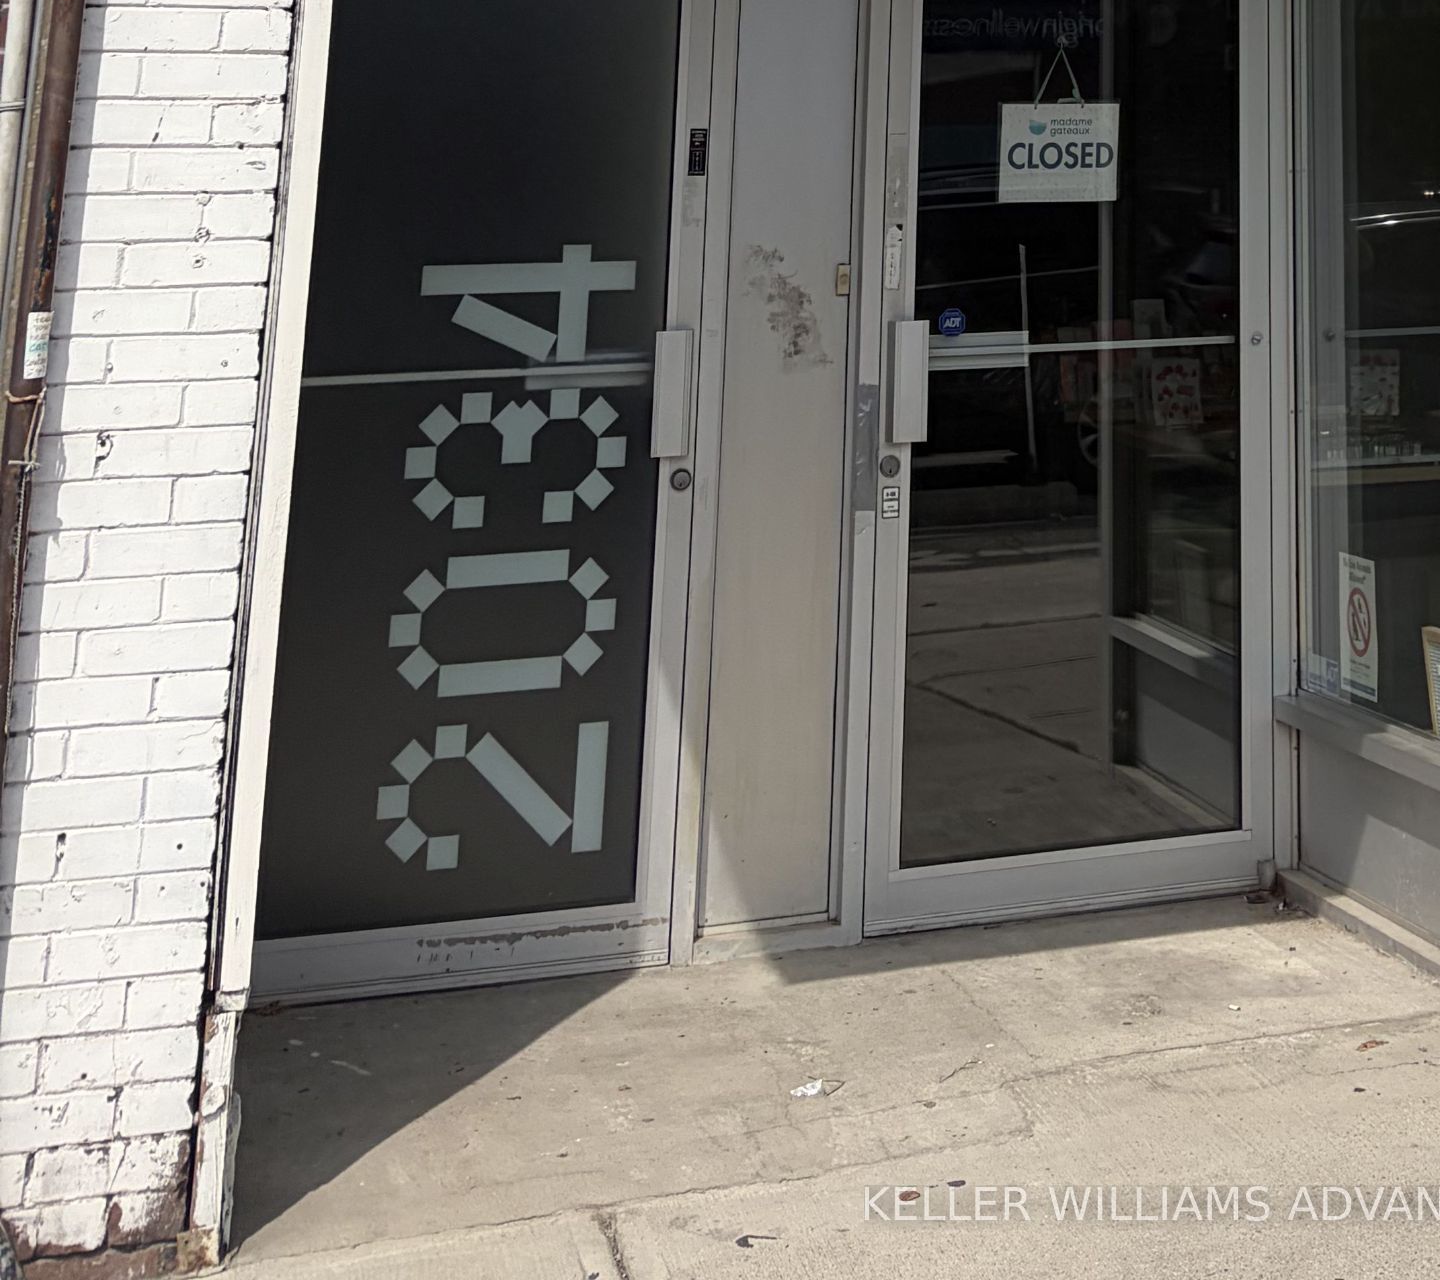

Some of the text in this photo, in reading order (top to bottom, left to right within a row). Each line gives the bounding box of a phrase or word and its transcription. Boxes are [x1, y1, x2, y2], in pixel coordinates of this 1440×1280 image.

[1050, 118, 1093, 127] madame
[1050, 127, 1090, 138] gateaux
[1007, 142, 1114, 170] CLOSED
[943, 317, 962, 329] ADT
[376, 243, 637, 871] 2034
